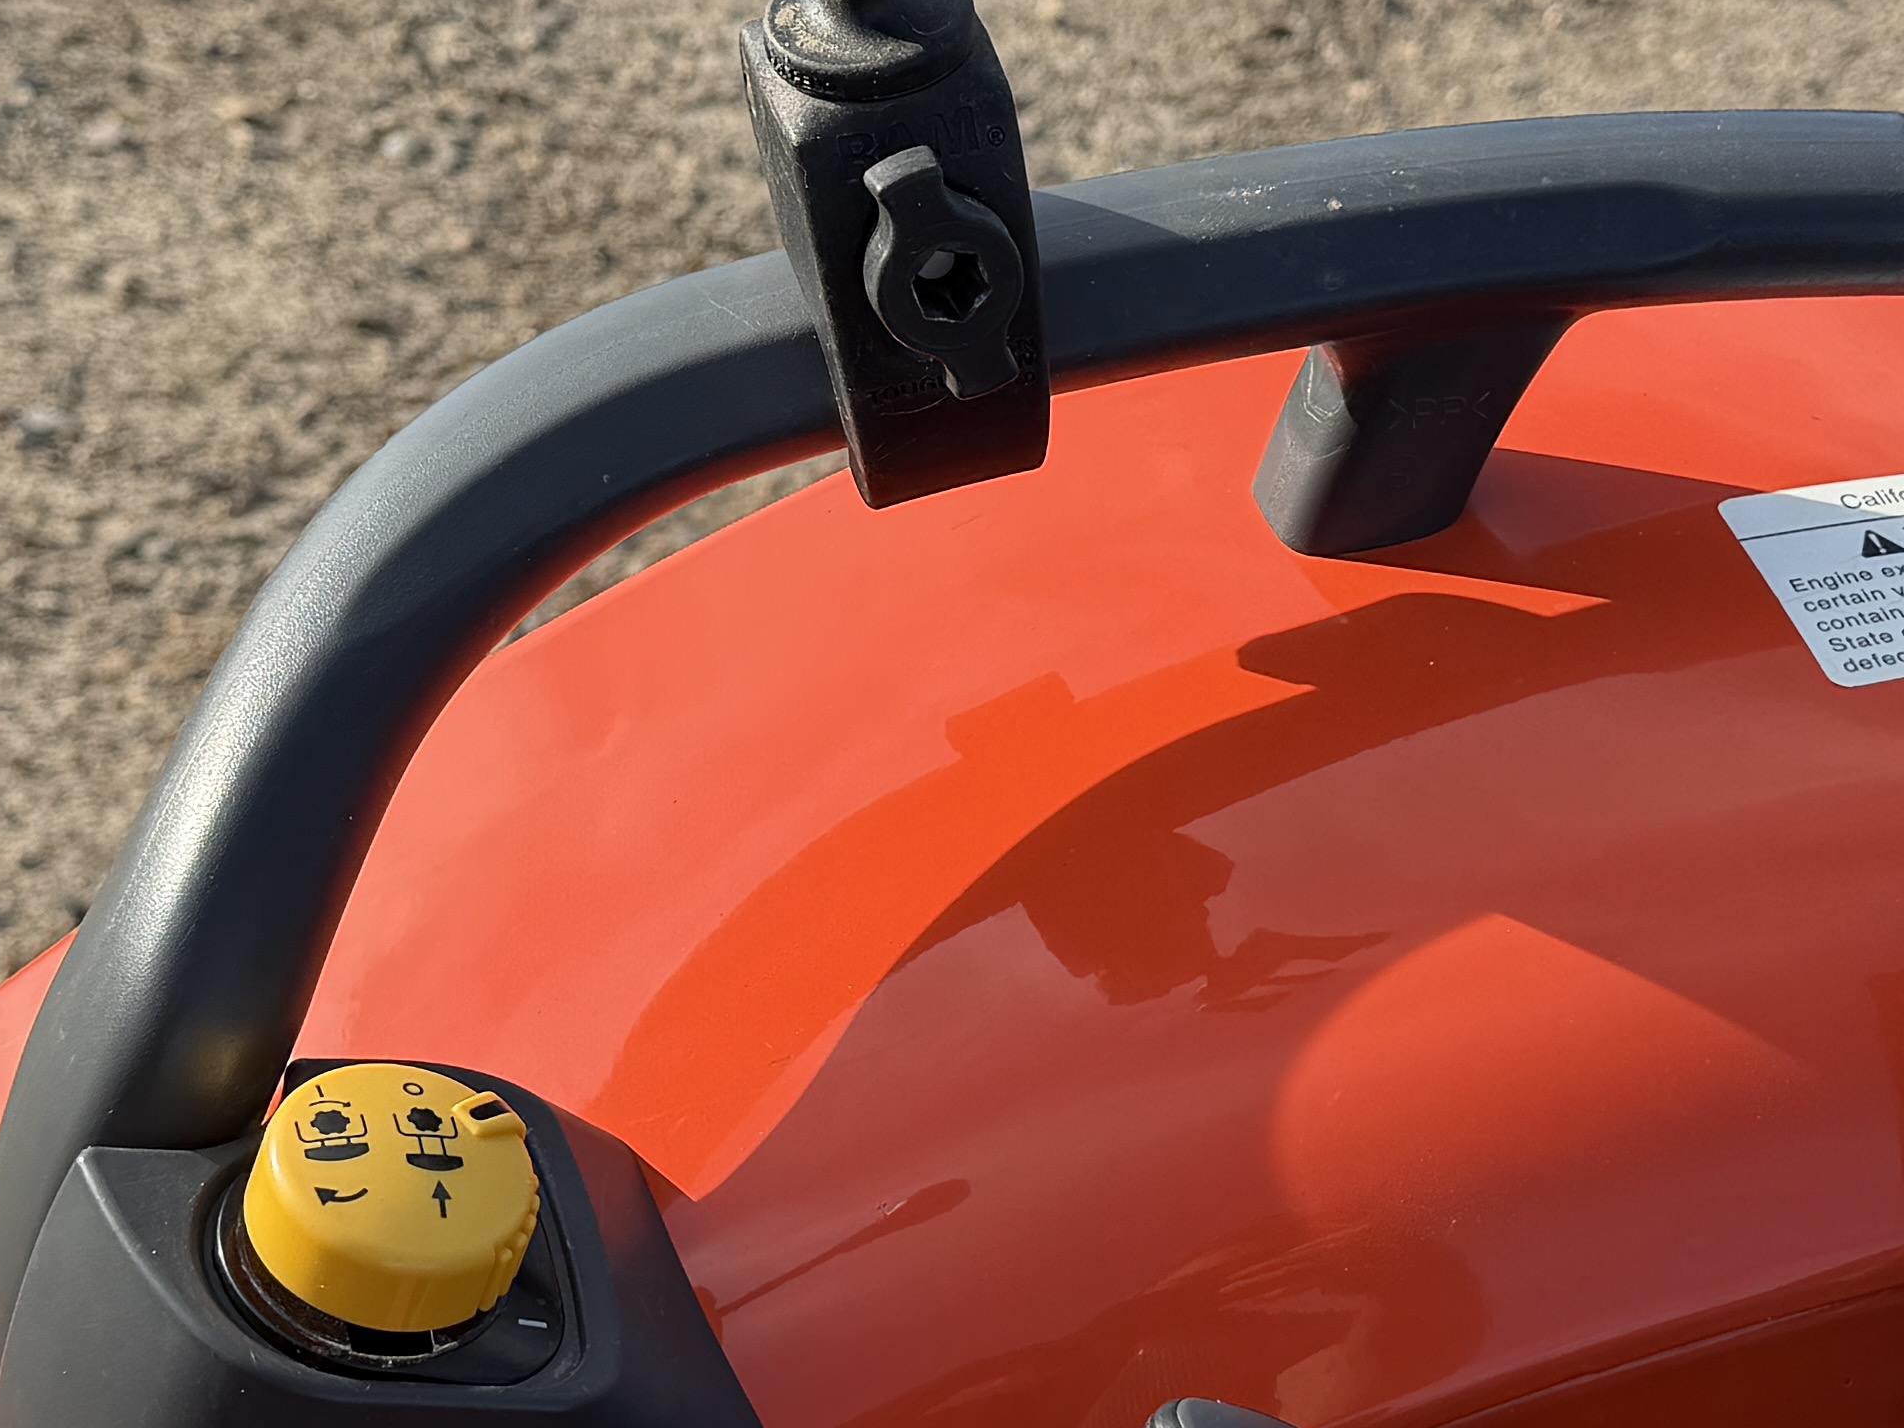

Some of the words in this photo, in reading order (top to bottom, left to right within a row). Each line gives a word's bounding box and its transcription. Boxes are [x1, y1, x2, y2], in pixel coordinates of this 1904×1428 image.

[1789, 570, 1873, 594] Engine
[1803, 589, 1886, 613] certain
[1816, 609, 1904, 633] contain
[1828, 632, 1894, 653] State
